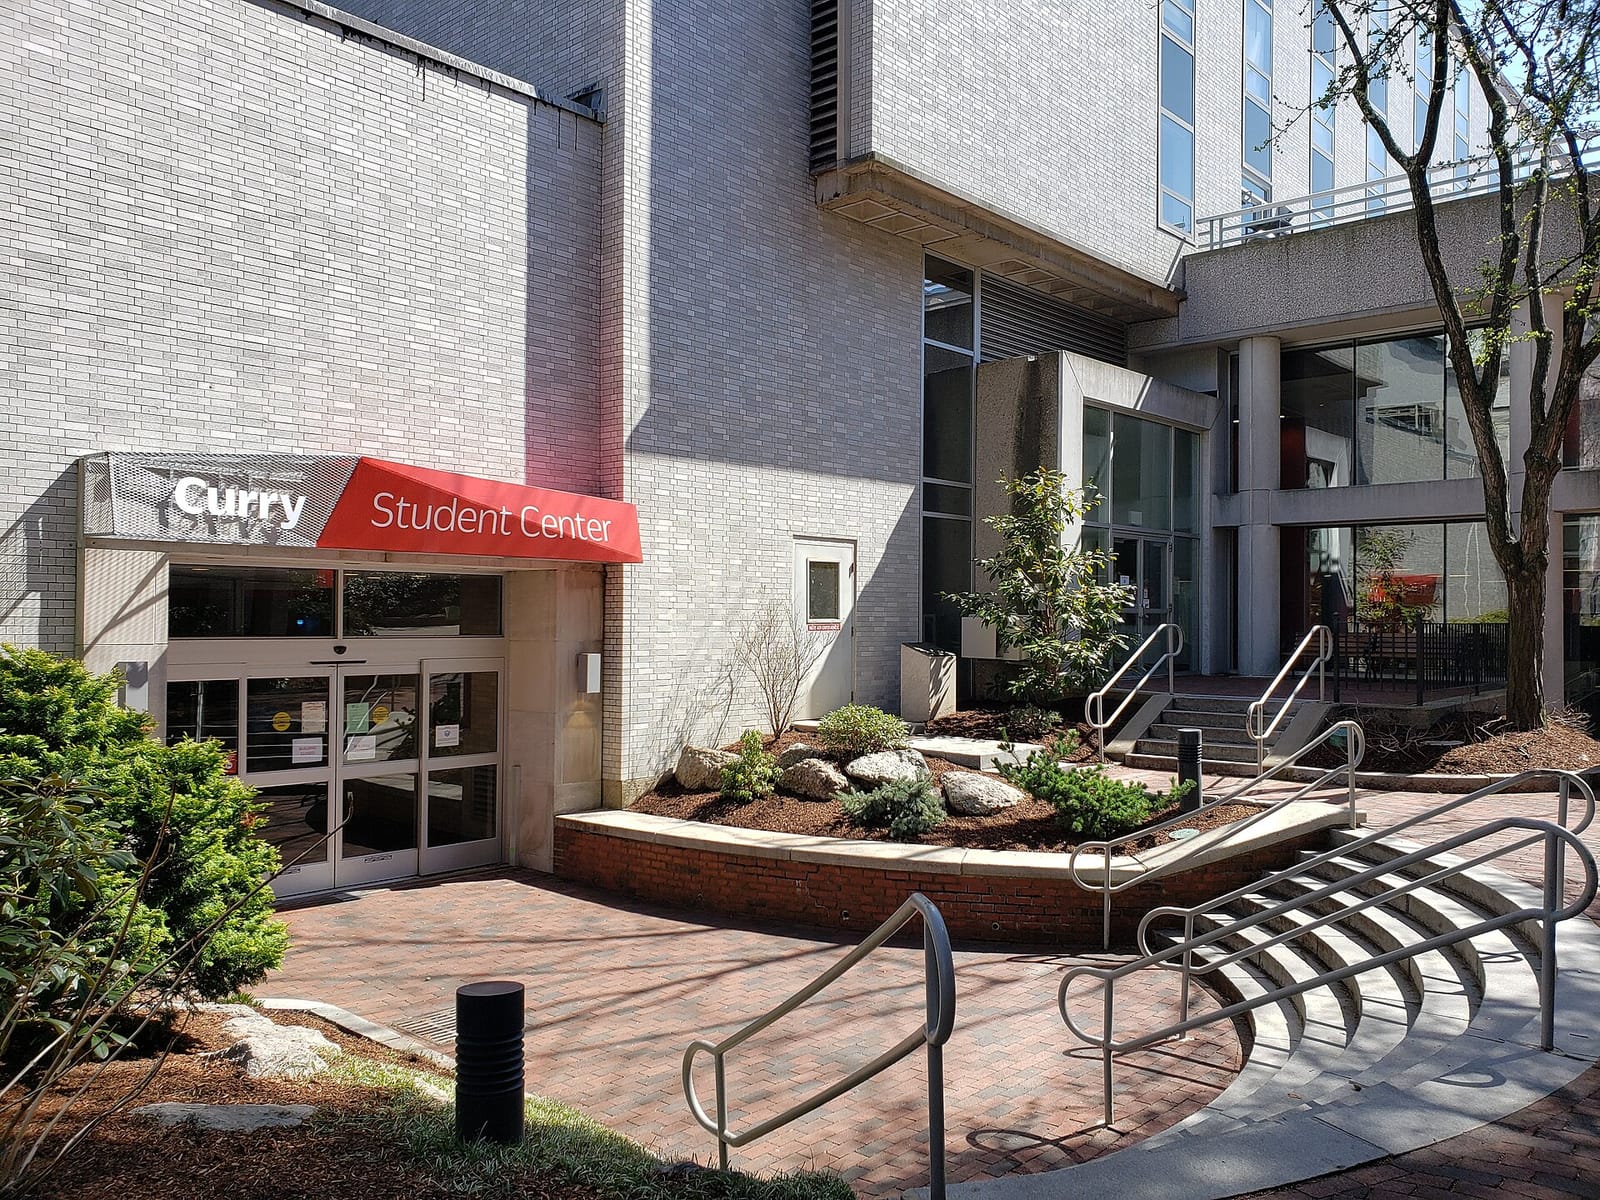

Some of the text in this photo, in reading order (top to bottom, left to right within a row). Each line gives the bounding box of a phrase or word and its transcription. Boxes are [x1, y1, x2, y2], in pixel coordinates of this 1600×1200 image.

[174, 476, 611, 542] Curry Student Center
